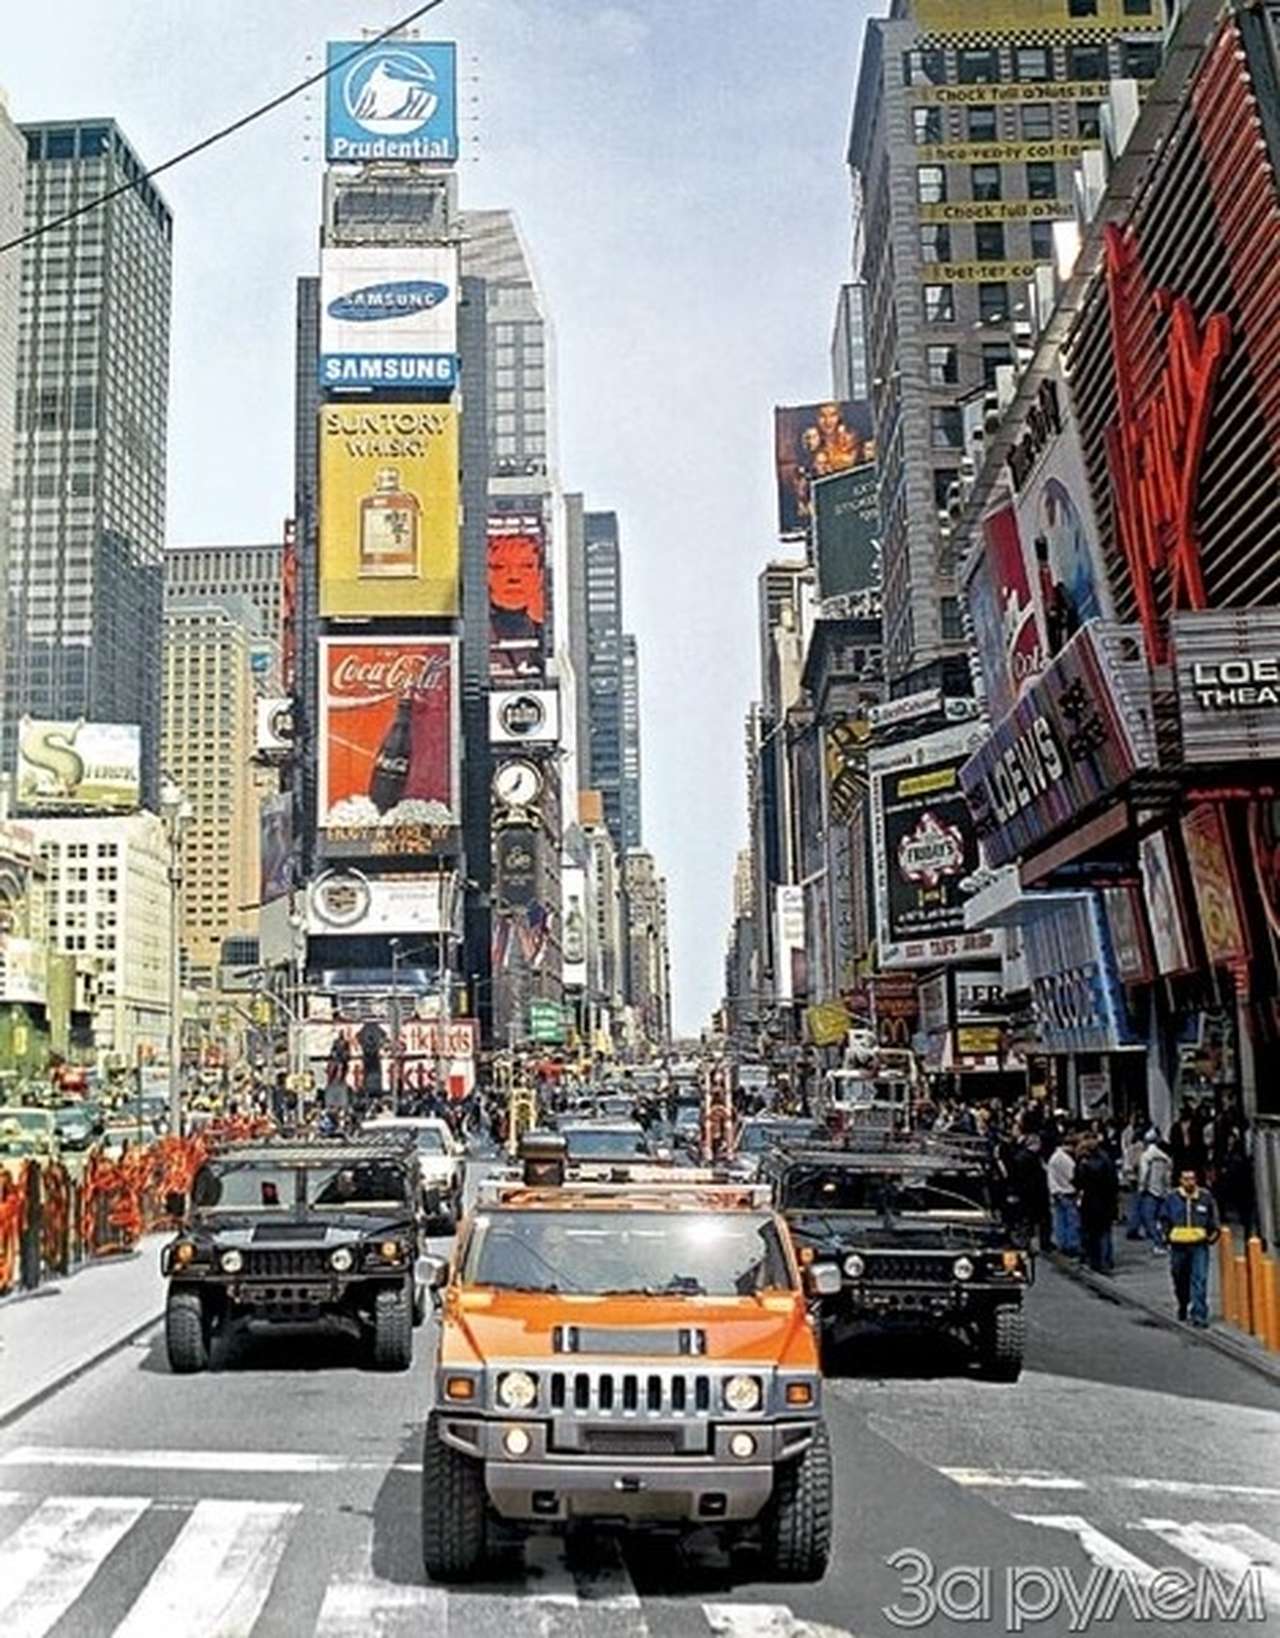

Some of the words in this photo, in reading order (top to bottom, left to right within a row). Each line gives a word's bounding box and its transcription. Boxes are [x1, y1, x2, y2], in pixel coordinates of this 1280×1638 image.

[332, 137, 449, 158] Prudential
[346, 291, 435, 310] SAMSUNG
[325, 357, 452, 382] SAMSUNG
[326, 413, 448, 435] SUNTORY
[984, 716, 1064, 825] LOEWS
